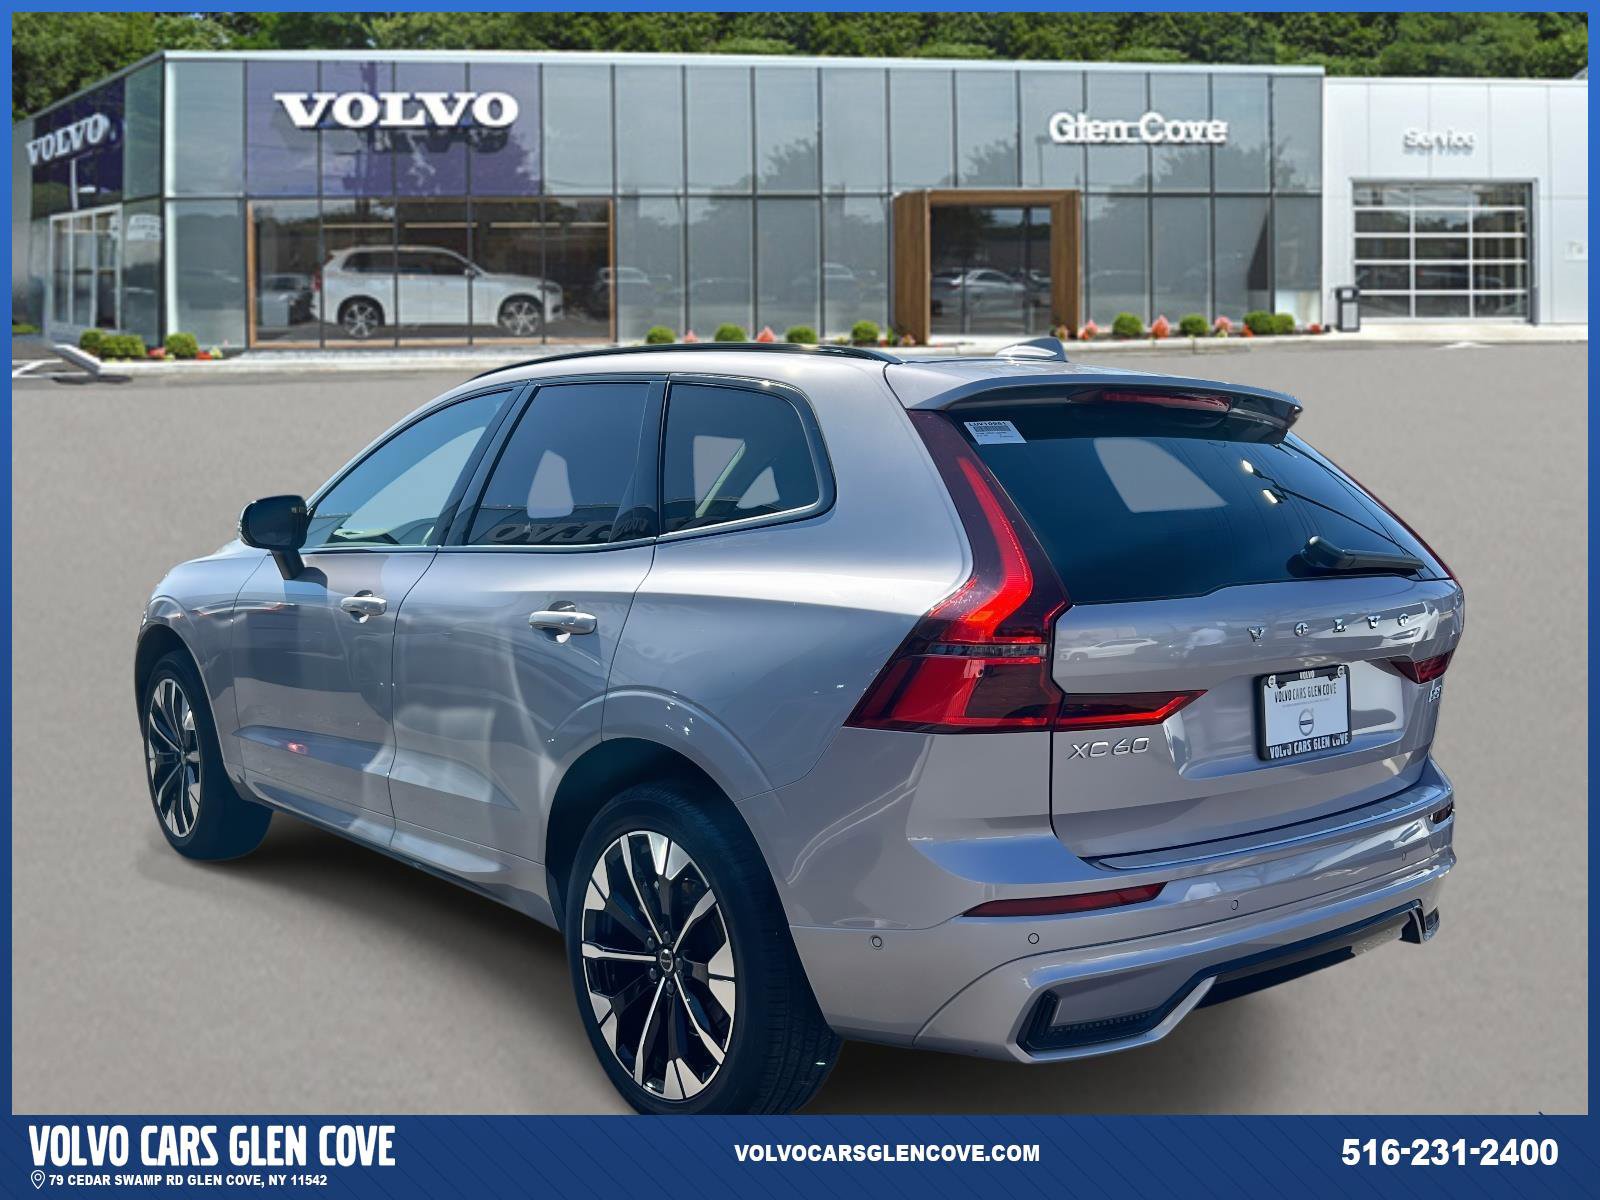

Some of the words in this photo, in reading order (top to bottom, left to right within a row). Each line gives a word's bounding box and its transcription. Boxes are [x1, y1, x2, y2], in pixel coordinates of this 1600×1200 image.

[273, 92, 519, 127] VOLVO
[26, 113, 110, 165] VOLVO
[1049, 112, 1130, 143] Glen
[1139, 112, 1228, 143] Cove
[1404, 127, 1476, 152] Service
[1248, 613, 1408, 642] VOLVO
[1274, 689, 1292, 703] VOLVO
[1292, 687, 1307, 700] CARS
[1307, 684, 1322, 698] GLEN
[1322, 683, 1337, 696] COVE
[1068, 737, 1149, 760] XC60
[1294, 739, 1311, 754] CARS
[1313, 735, 1330, 750] GLEN
